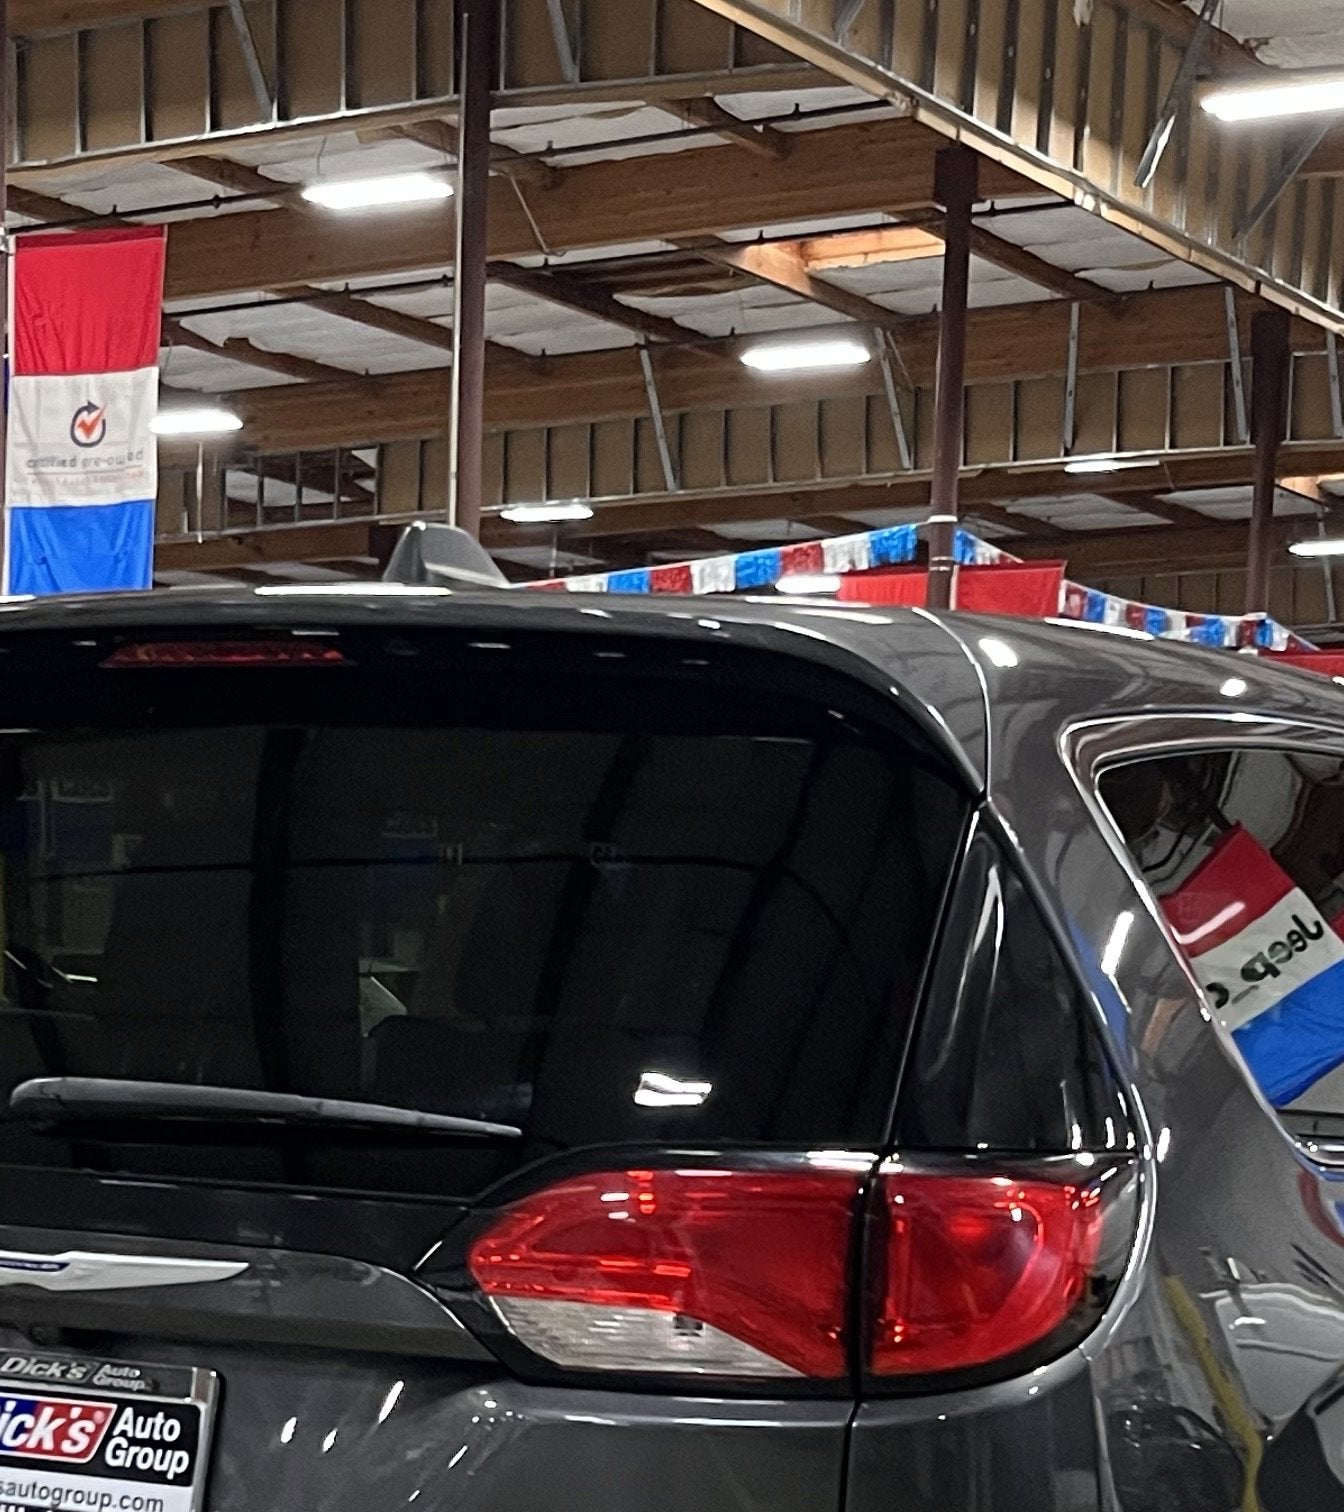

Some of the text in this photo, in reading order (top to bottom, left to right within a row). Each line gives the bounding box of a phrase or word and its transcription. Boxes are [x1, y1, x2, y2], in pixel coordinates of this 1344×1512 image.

[0, 1355, 89, 1381] Dick's
[102, 1363, 141, 1379] Auto
[113, 1406, 181, 1442] Auto
[105, 1436, 190, 1480] Group
